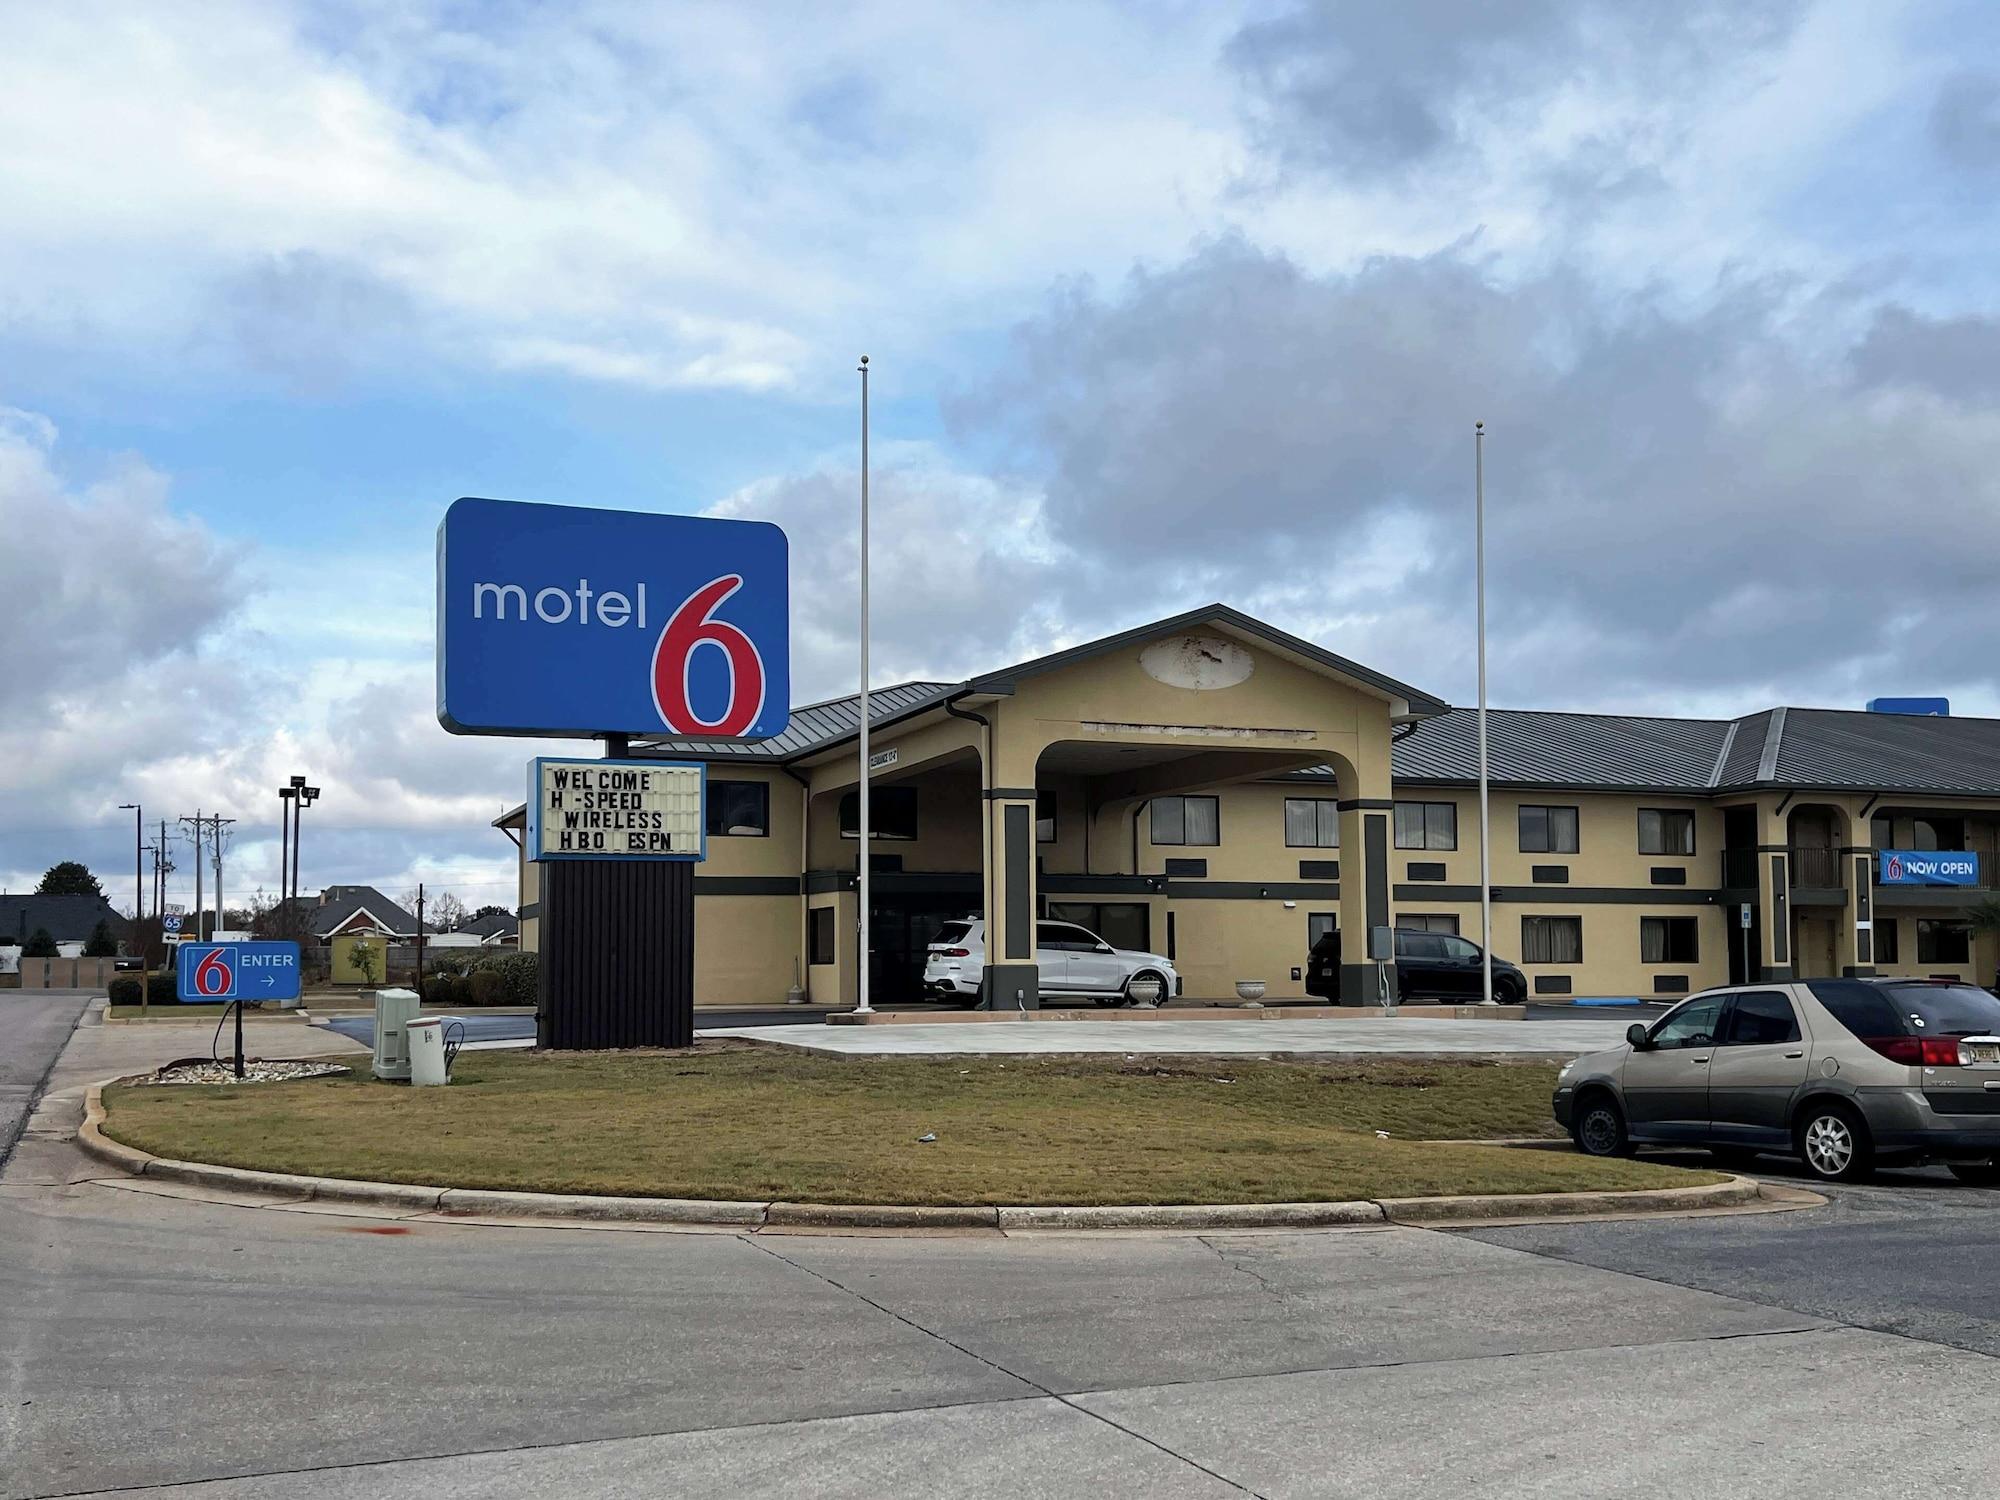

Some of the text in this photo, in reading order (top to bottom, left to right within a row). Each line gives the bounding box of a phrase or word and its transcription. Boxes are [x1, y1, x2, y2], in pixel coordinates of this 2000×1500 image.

[473, 573, 767, 738] motel 6
[553, 771, 650, 791] WELCOME
[551, 791, 563, 808] H
[564, 811, 662, 829] WIRELESS
[560, 831, 671, 850] HBO ESPN
[1906, 862, 1938, 875] NOW
[1940, 862, 1973, 875] OPEN
[165, 917, 181, 929] 65
[194, 946, 294, 997] 6 ENTER
